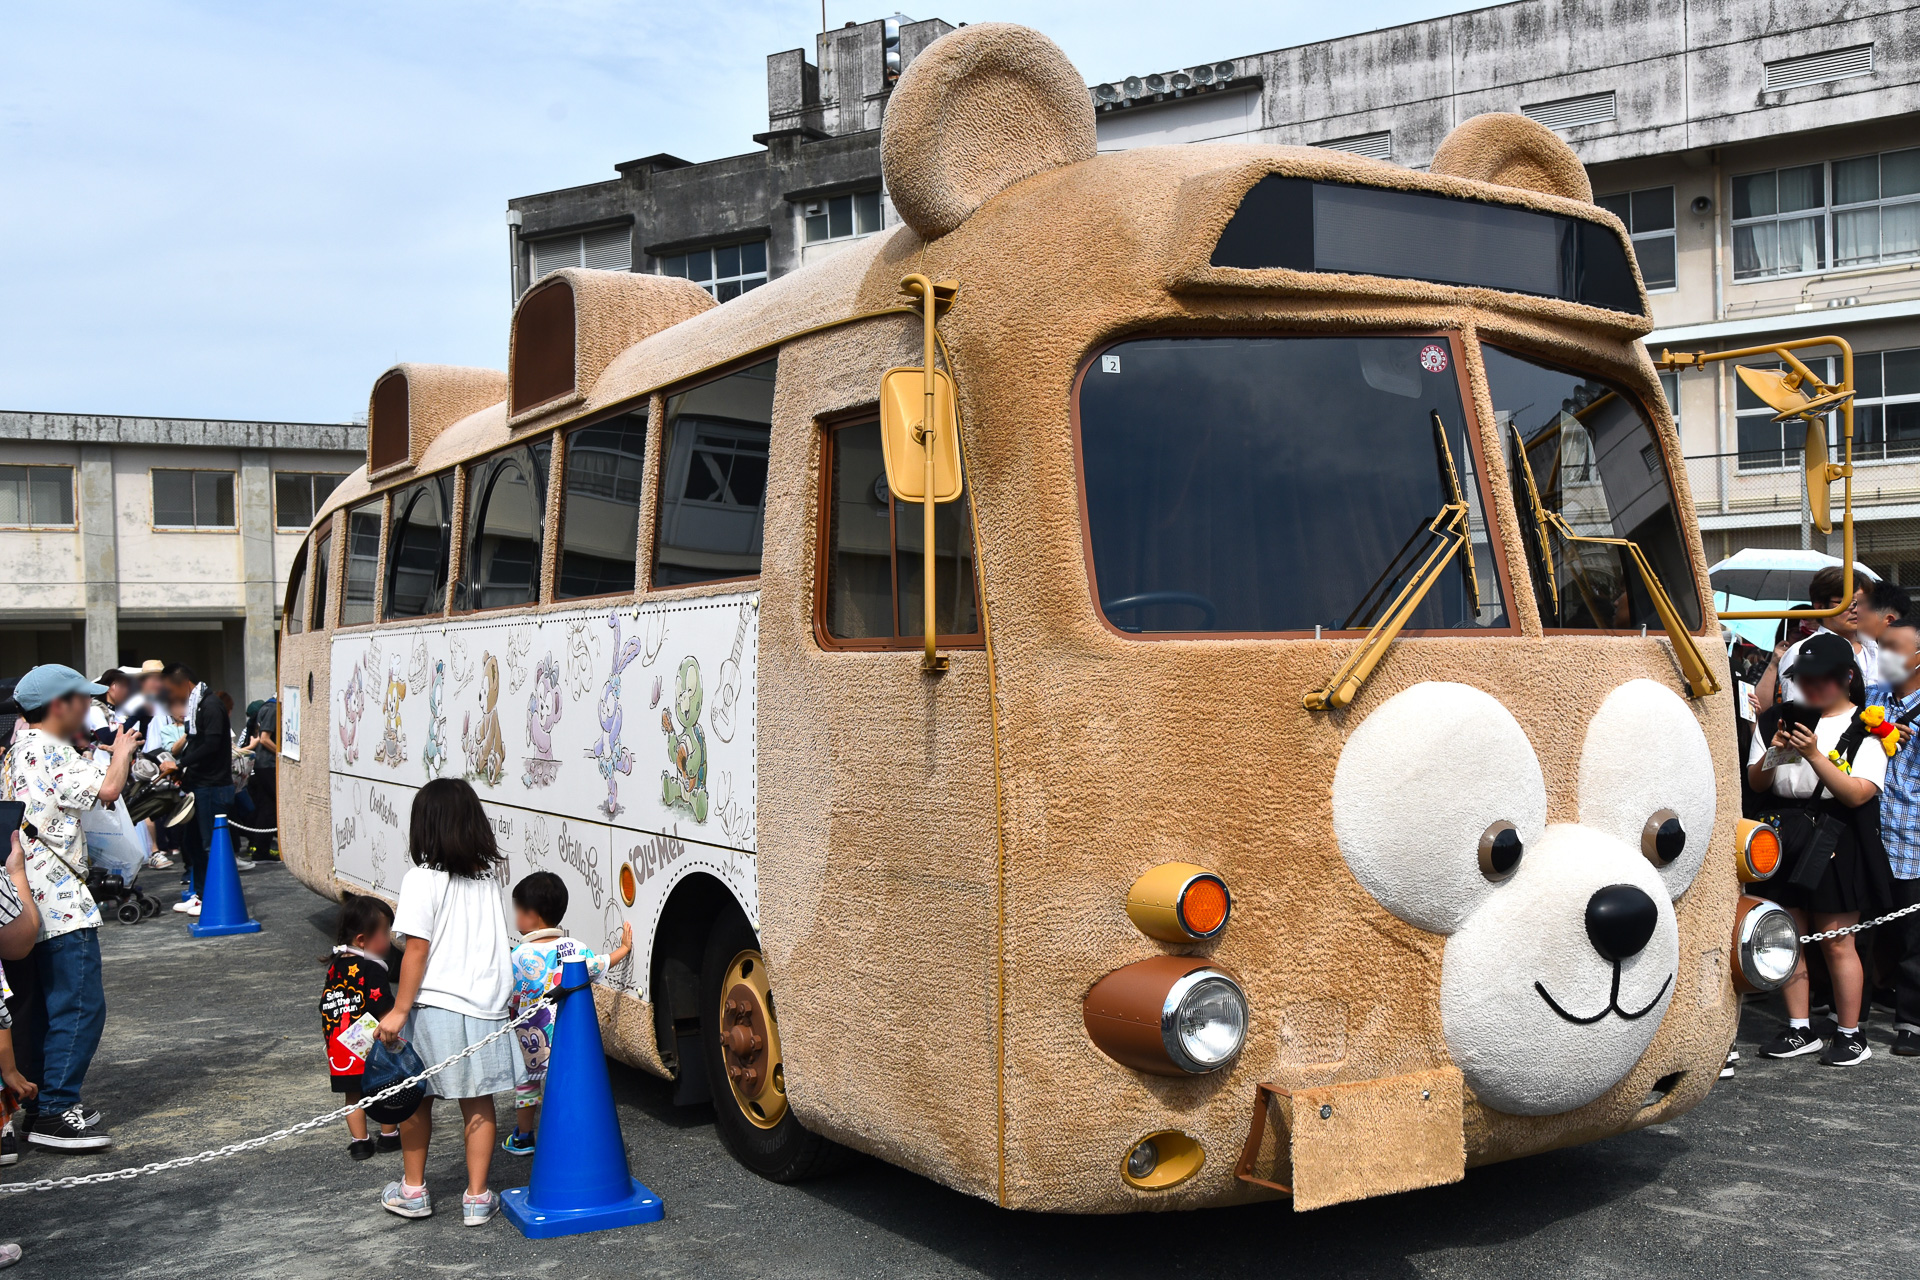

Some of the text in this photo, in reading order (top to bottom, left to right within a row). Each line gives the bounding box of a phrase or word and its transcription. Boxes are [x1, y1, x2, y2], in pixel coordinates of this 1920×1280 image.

[1110, 361, 1116, 371] 2
[498, 815, 513, 839] day!
[337, 997, 350, 1006] the
